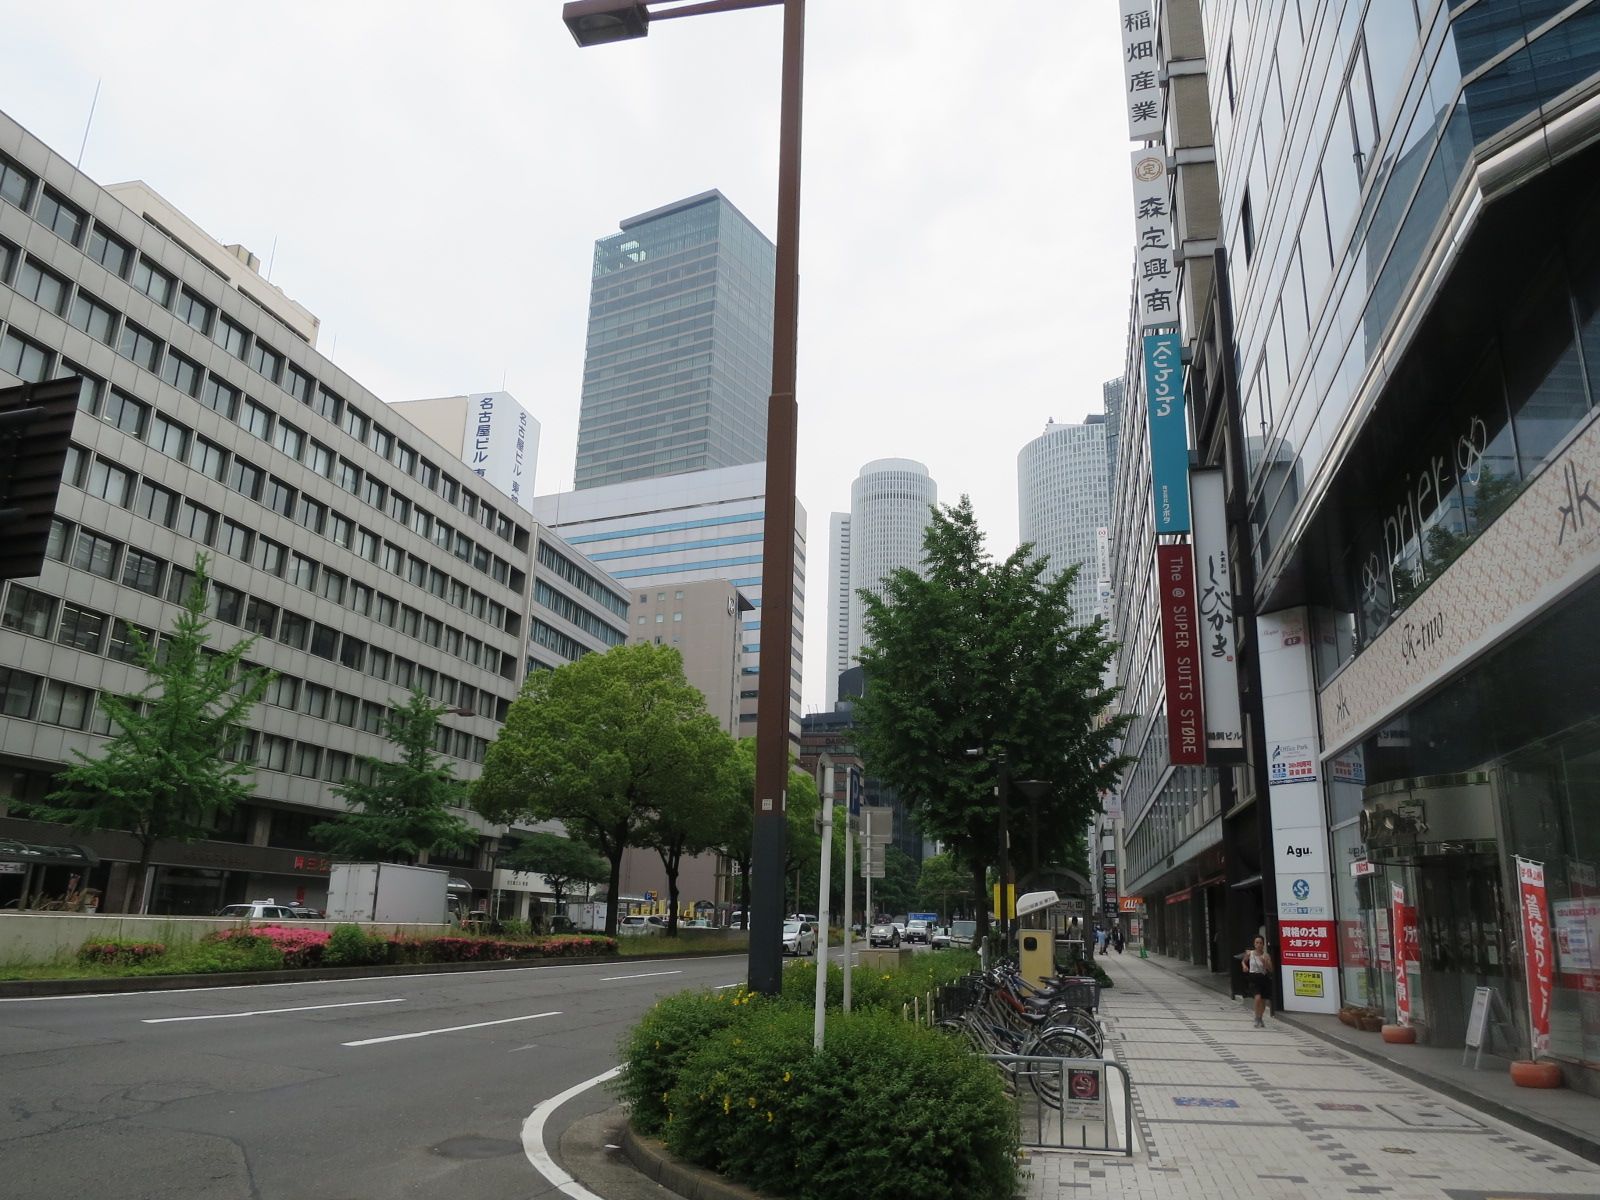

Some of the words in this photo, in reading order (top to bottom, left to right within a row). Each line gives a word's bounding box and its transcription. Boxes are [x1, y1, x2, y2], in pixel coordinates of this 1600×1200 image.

[1124, 9, 1158, 123] 稲畑産業
[1137, 196, 1173, 314] 森定興商
[1152, 340, 1175, 417] Kubota
[1170, 557, 1182, 582] The
[1173, 605, 1190, 649] SUPER
[1177, 657, 1193, 701] SUITS
[1286, 845, 1312, 857] Agu.
[1124, 899, 1138, 909] au
